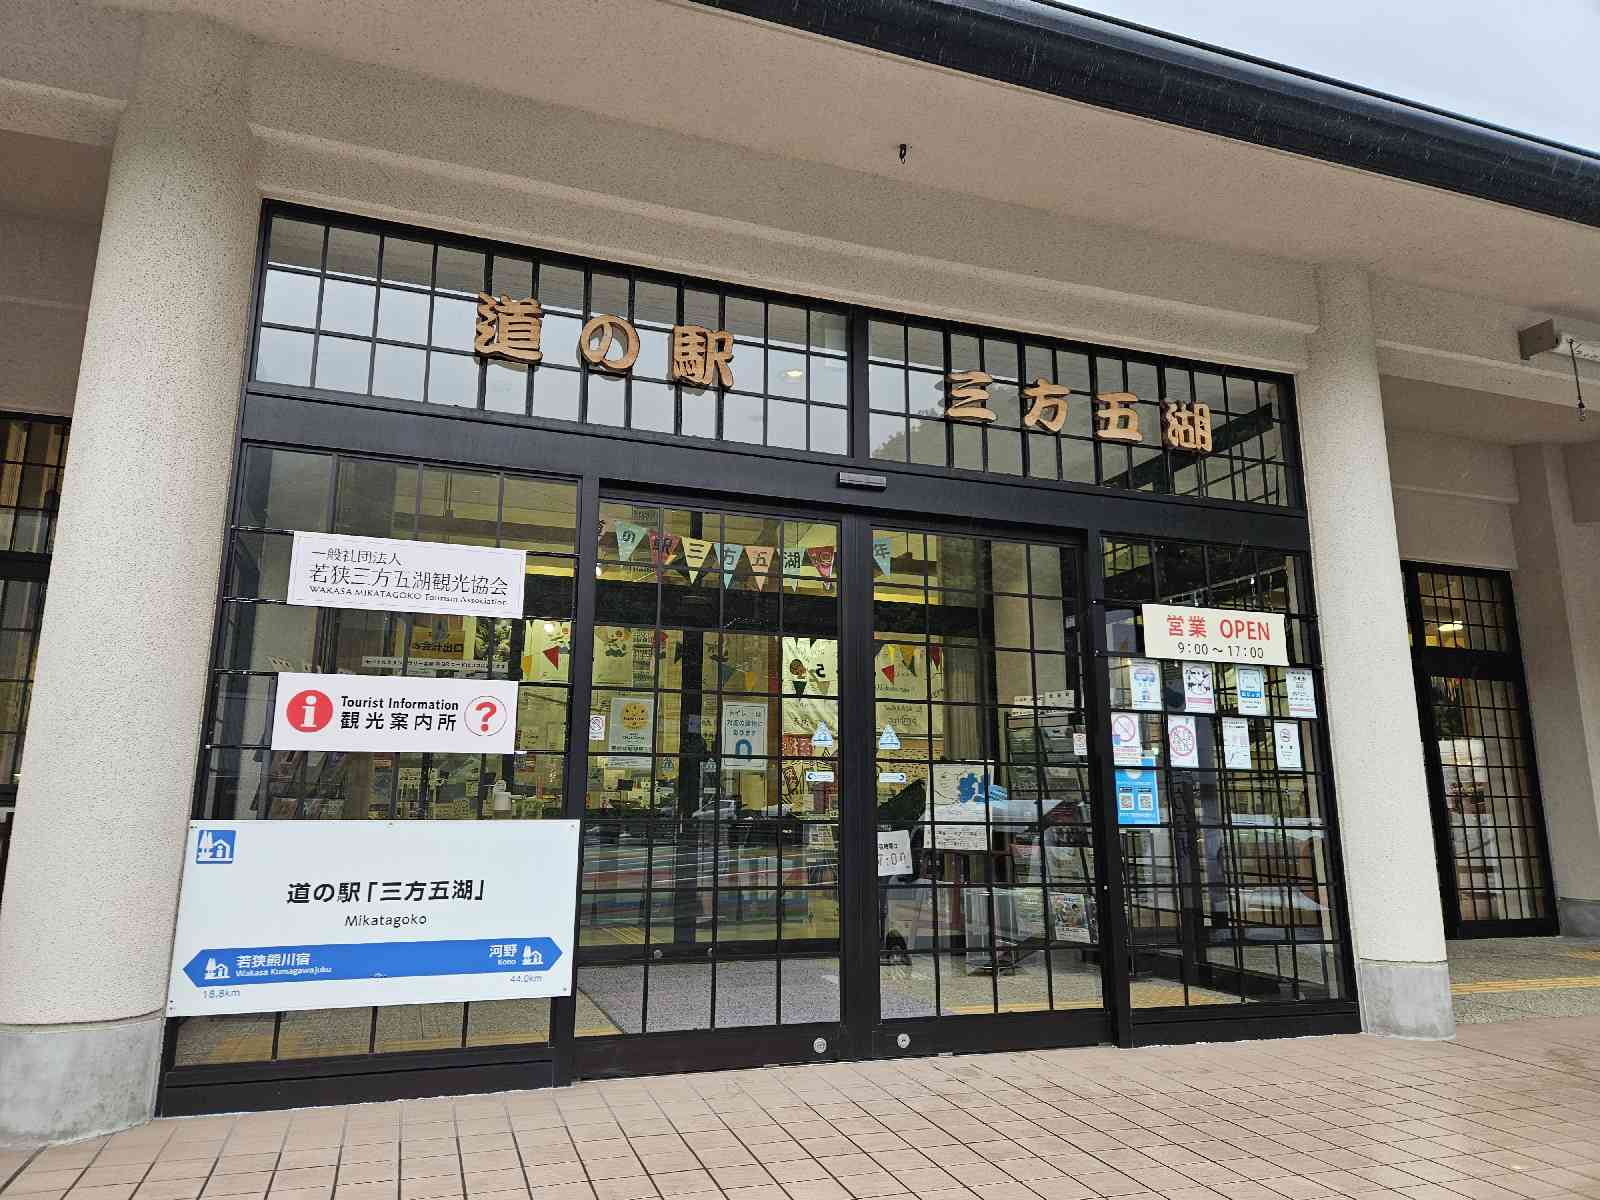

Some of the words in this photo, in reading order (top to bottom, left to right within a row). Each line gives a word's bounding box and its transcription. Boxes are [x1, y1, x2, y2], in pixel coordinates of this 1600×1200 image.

[474, 292, 734, 388] 道の駅
[945, 370, 1213, 452] 三方五湖
[311, 548, 401, 566] 一般社団法人
[310, 563, 508, 595] 若狭三方五湖観光協会
[310, 585, 352, 595] WAKASA
[355, 589, 421, 600] MIKATAGOKO
[460, 596, 507, 606] Association
[1167, 614, 1208, 638] 営業
[1219, 619, 1271, 641] OPEN
[341, 696, 384, 708] Tourist
[388, 697, 459, 711] Information
[341, 711, 457, 732] 観光案内所
[286, 879, 485, 904] 道の駅「三方五湖」
[344, 914, 427, 928] Mikatagoko
[235, 953, 312, 969] 若狭熊川宿
[488, 943, 518, 958] 河野
